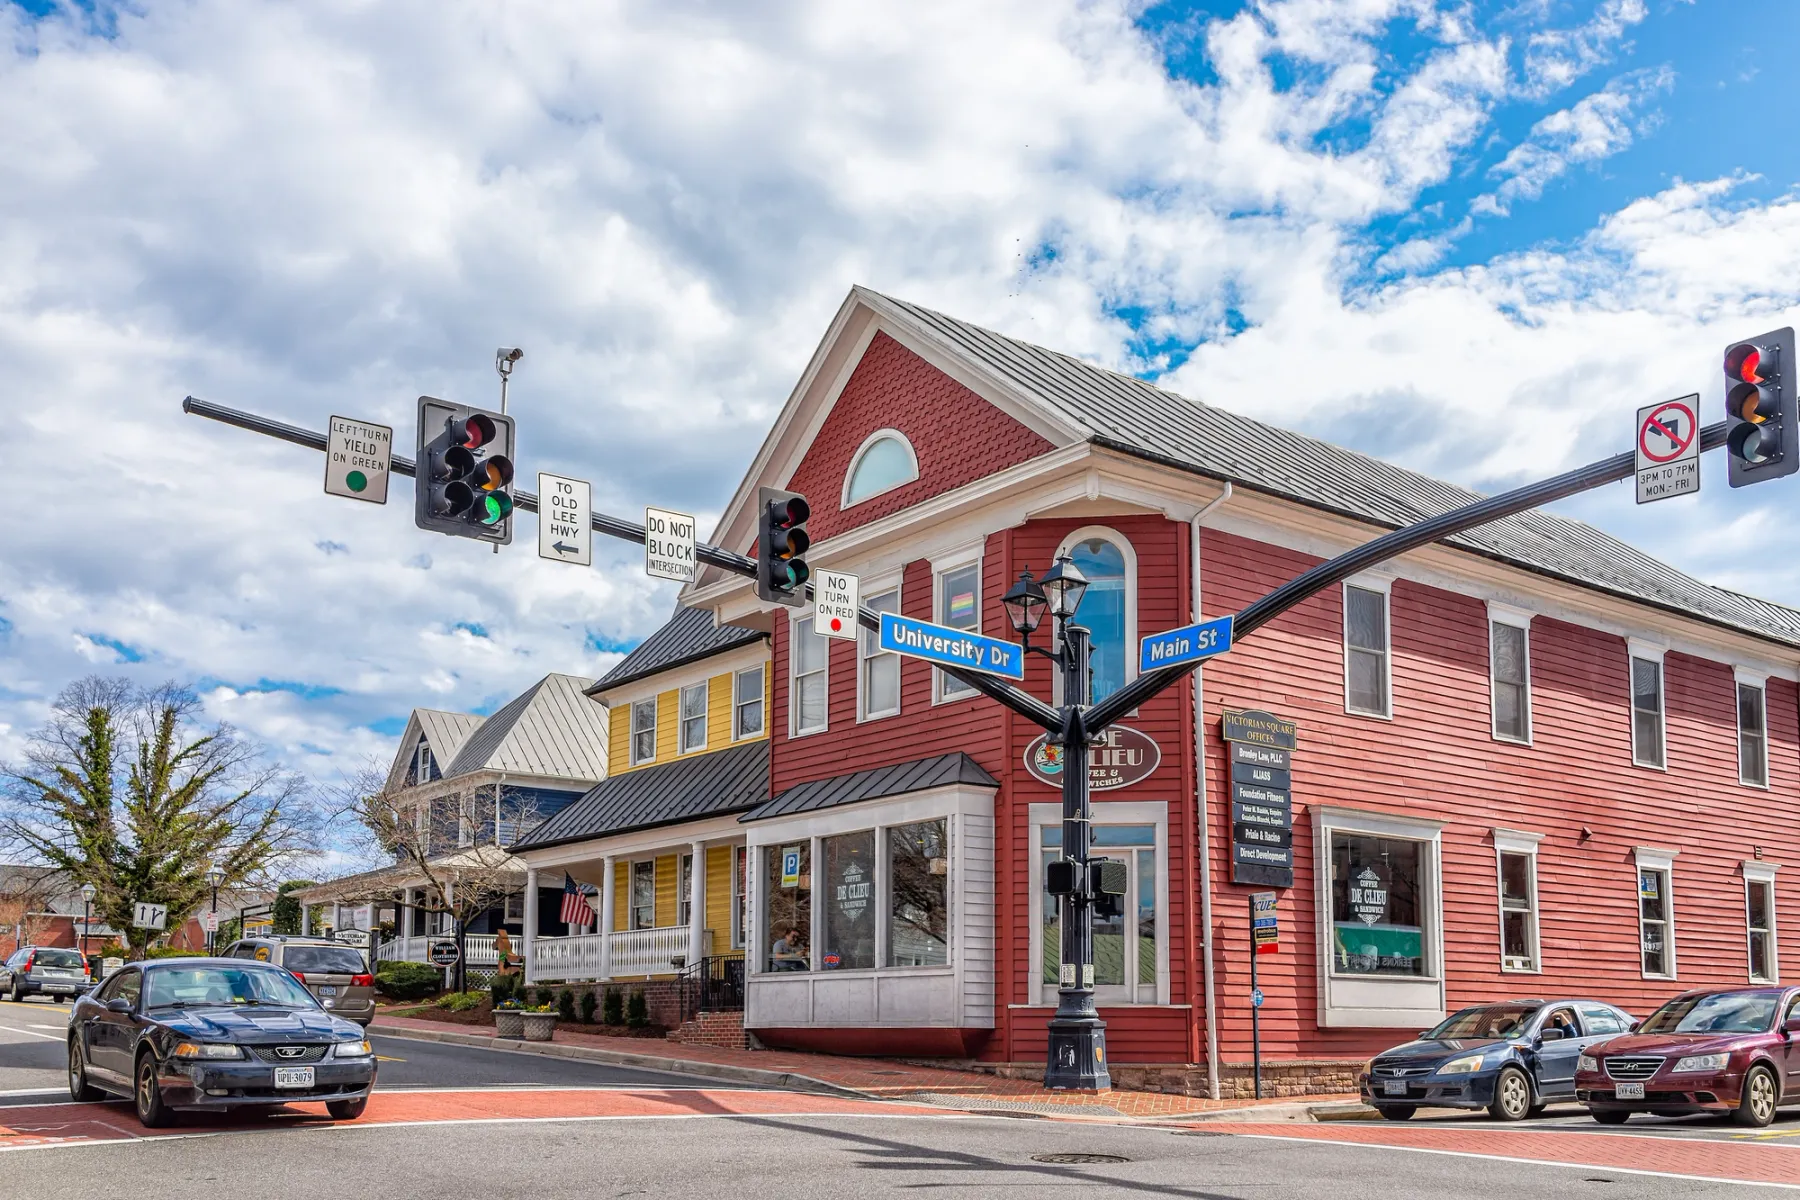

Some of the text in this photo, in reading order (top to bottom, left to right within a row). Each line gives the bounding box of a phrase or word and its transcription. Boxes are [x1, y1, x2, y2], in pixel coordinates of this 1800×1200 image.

[333, 422, 389, 442] LEFT TURN
[344, 437, 377, 455] YIELD
[333, 452, 384, 470] ON GREEN
[1640, 463, 1695, 484] 3PM TO 7PM
[556, 481, 572, 494] TO
[1675, 478, 1690, 490] FRI
[551, 495, 578, 509] OLD
[553, 510, 577, 524] LEE
[550, 523, 579, 538] HWY
[649, 517, 692, 539] DO NOT
[649, 539, 693, 561] BLOCK
[648, 559, 693, 576] INTERSECTION
[828, 576, 847, 590] NO
[825, 591, 849, 604] TURN
[819, 604, 854, 618] ON RED
[893, 623, 1010, 667] University Dr
[1151, 628, 1218, 661] Main St
[1226, 714, 1294, 735] VICTORIAN SQUARE
[1246, 730, 1275, 744] OFFICES
[1088, 748, 1143, 766] LIEU
[1258, 750, 1270, 763] Law,
[1270, 752, 1283, 764] PLLC
[1253, 769, 1271, 781] ALIASS
[1240, 787, 1284, 803] Foundation Fitness
[1259, 830, 1264, 840] &
[1264, 831, 1281, 843] Racine
[1240, 847, 1287, 862] Direct Development
[837, 882, 870, 900] DE CLIEU
[1360, 880, 1378, 888] COFFEE
[1351, 888, 1387, 905] DE CLIEU
[1254, 900, 1272, 911] CUE
[1360, 905, 1384, 914] SANDWICH
